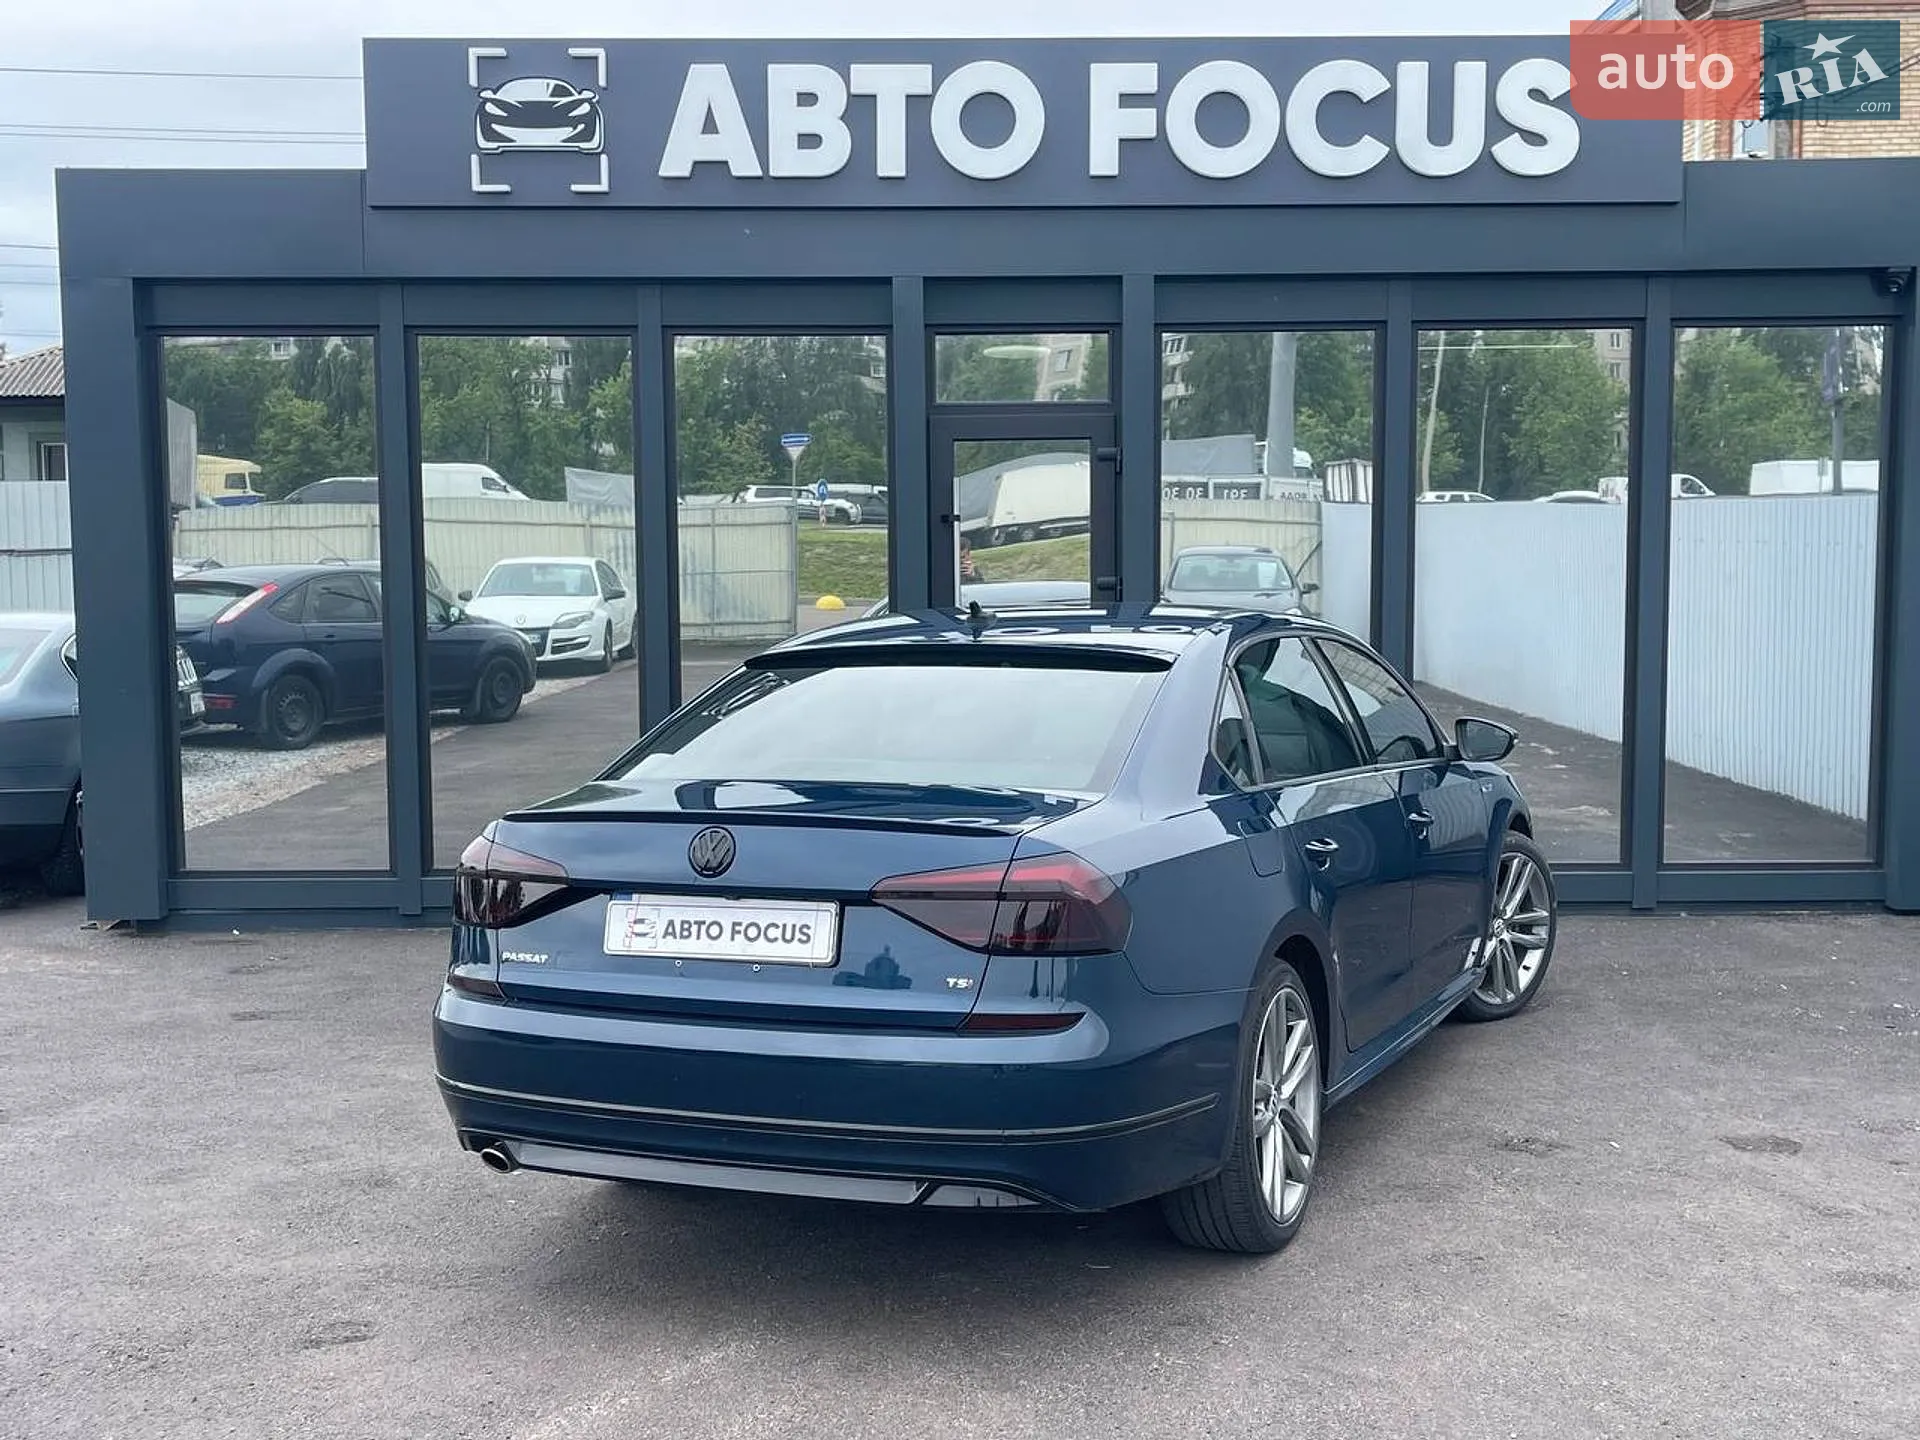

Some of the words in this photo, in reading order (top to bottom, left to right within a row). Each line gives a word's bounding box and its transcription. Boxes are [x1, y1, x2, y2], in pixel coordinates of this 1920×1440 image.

[657, 60, 1046, 180] АВТО
[1088, 57, 1582, 180] FOCUS
[662, 918, 724, 941] АВТО
[730, 921, 812, 944] FOCUS
[502, 951, 549, 965] PASSAT
